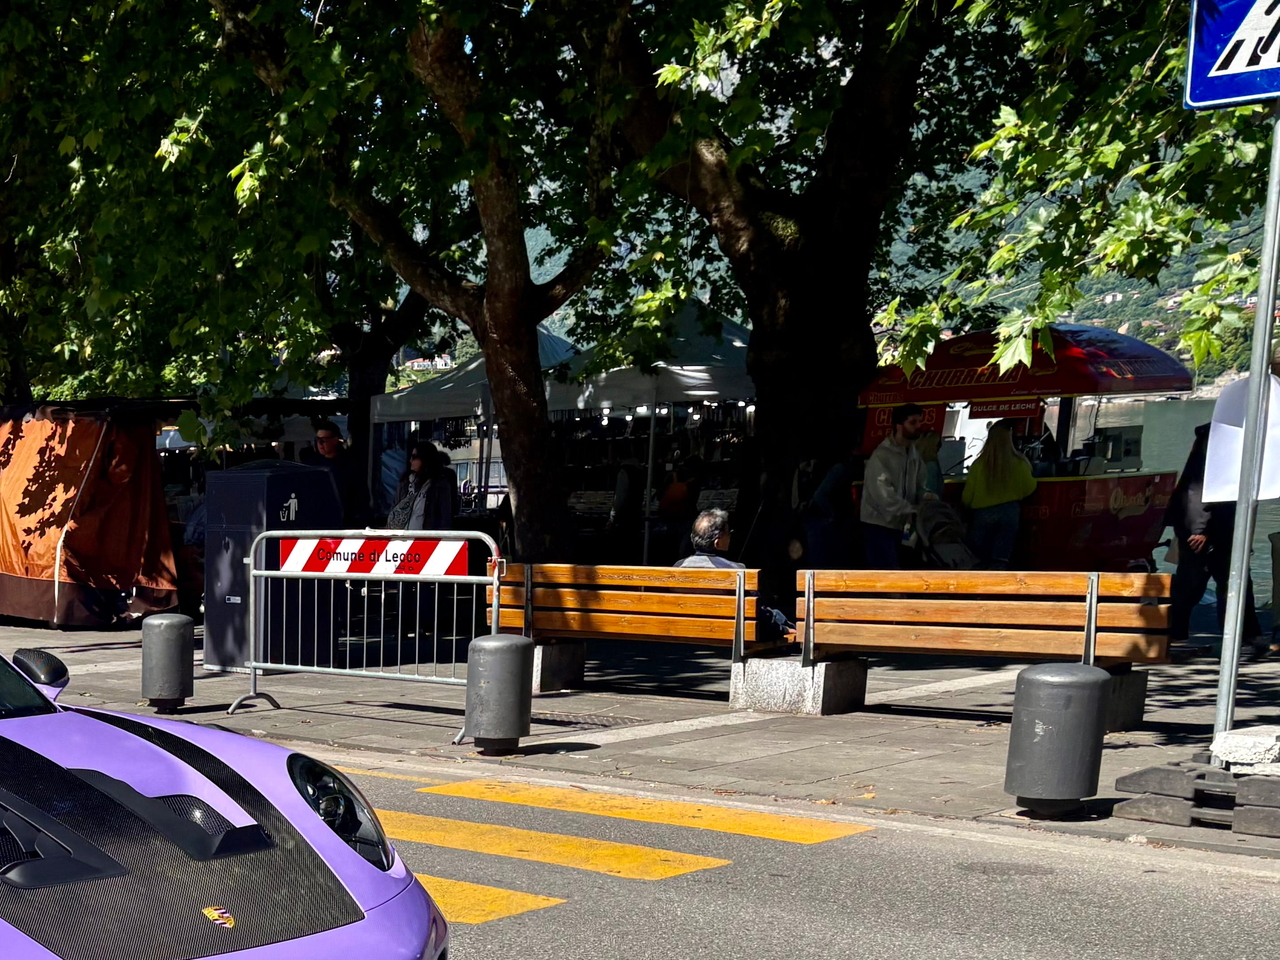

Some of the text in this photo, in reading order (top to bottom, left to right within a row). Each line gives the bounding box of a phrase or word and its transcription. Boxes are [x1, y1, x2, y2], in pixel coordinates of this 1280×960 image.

[972, 404, 997, 412] DULCE
[1011, 402, 1037, 410] LECHE
[317, 548, 364, 562] Comune
[385, 549, 421, 563] Lecco
